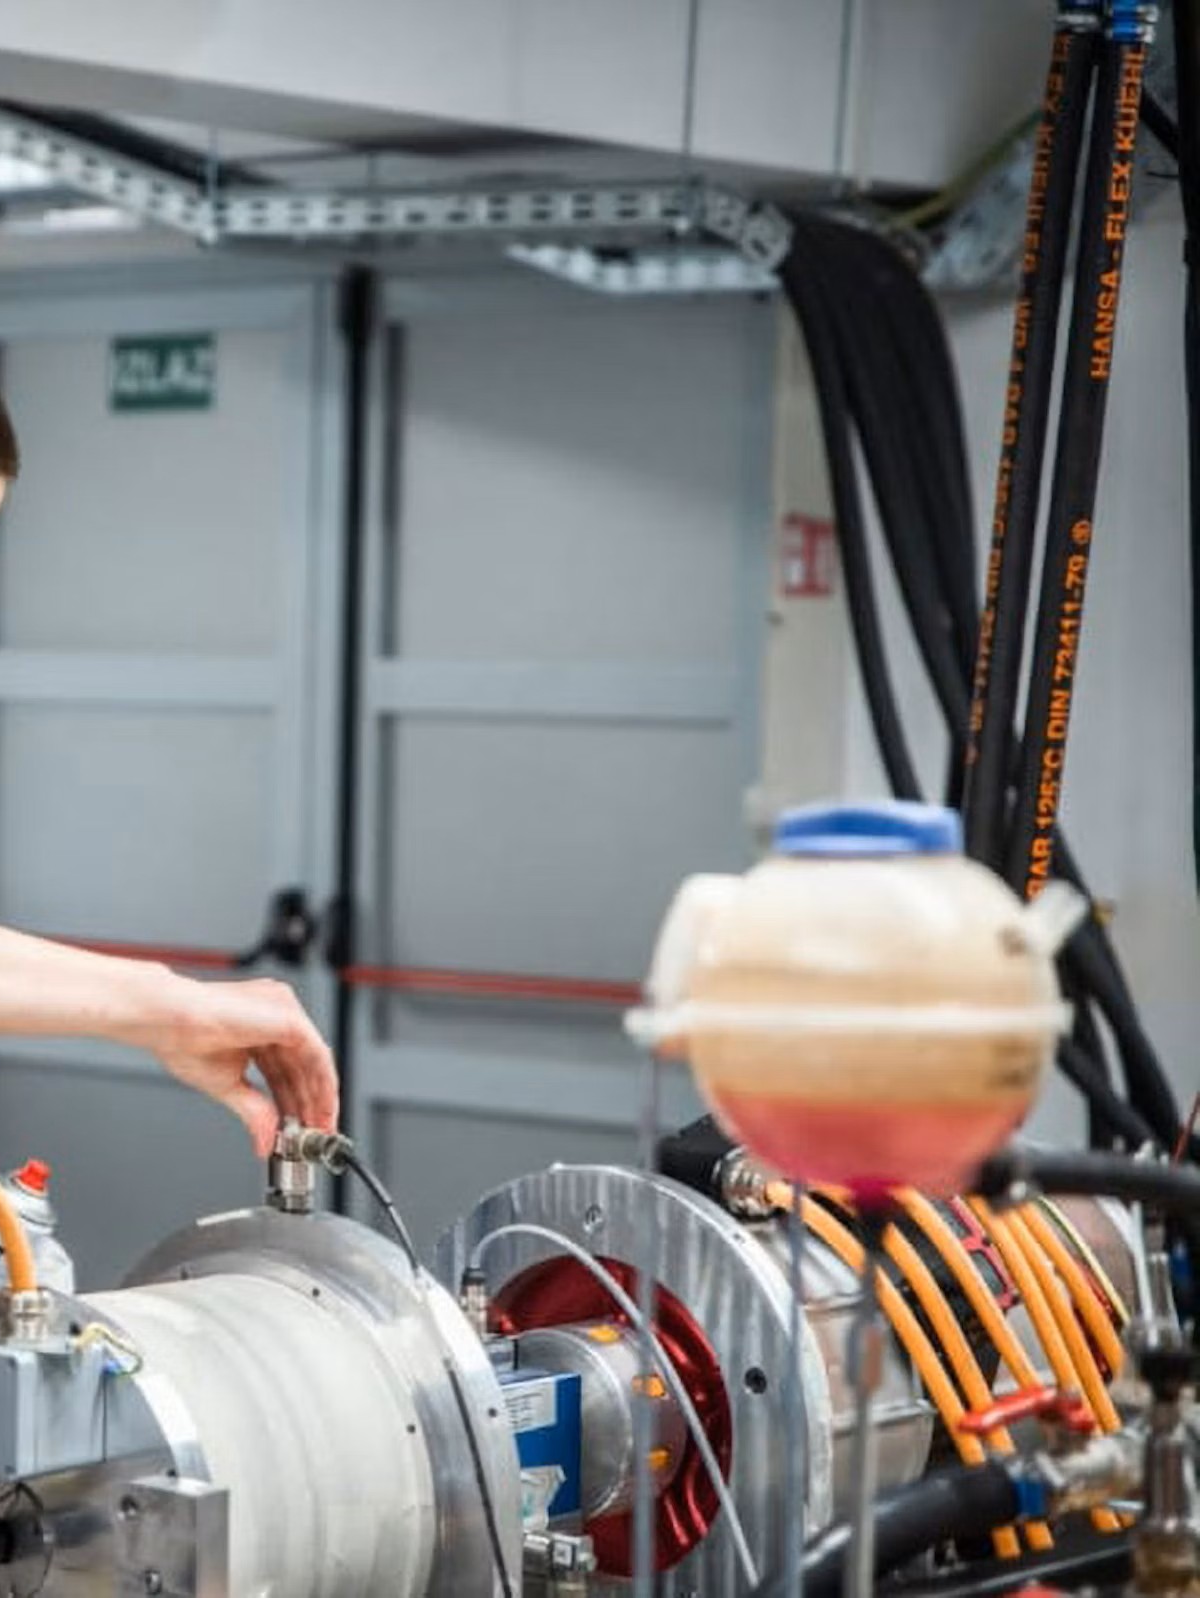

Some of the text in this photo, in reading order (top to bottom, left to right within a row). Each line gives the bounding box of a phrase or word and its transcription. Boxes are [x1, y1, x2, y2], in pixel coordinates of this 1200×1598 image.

[1090, 270, 1121, 379] HANSA
[1053, 554, 1088, 682] 73411-79
[1046, 689, 1072, 739] DIN
